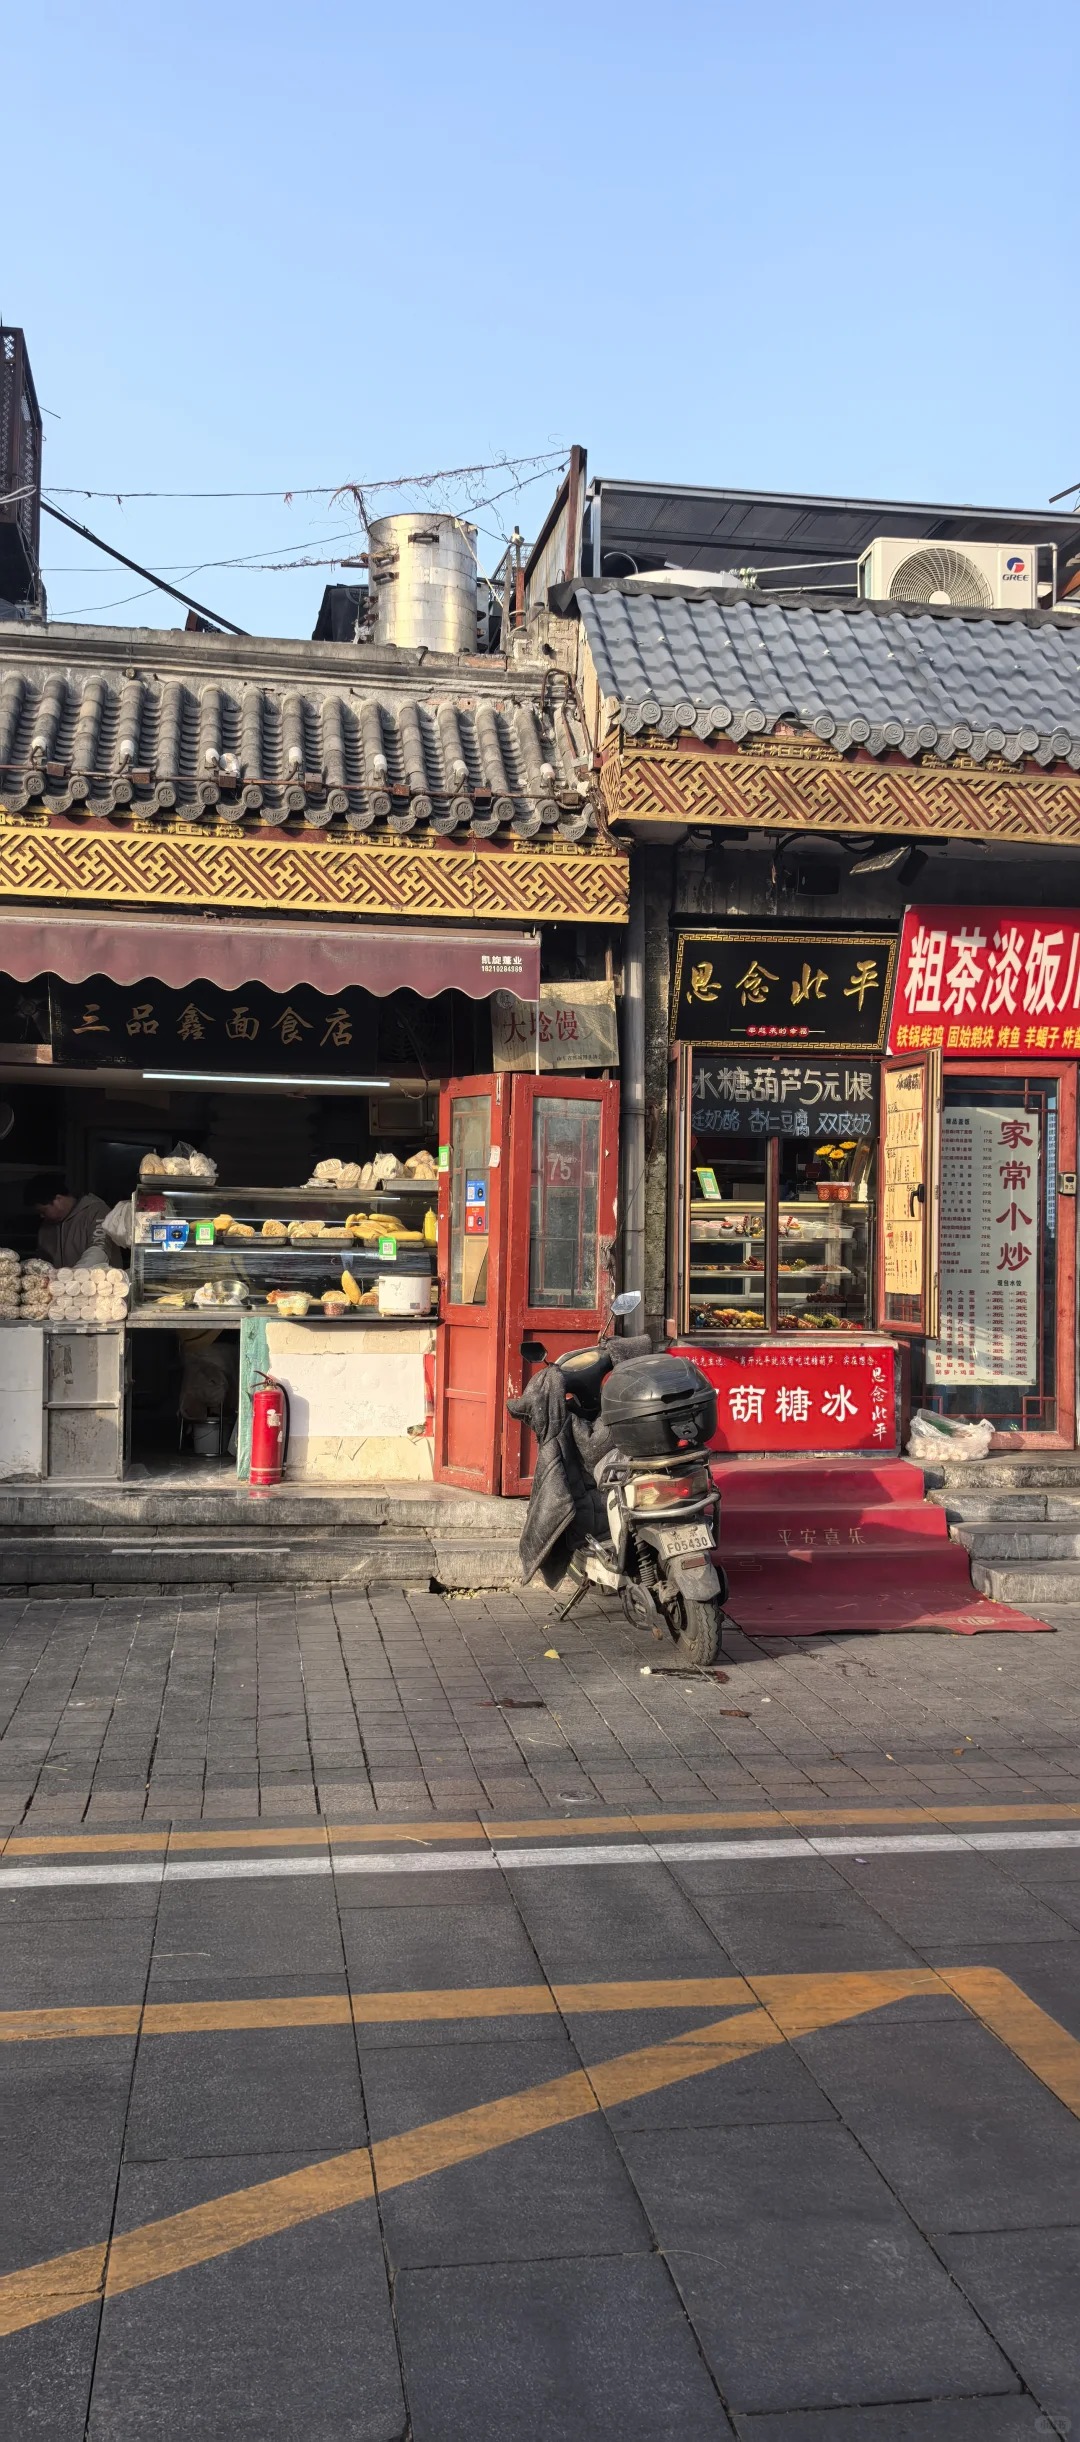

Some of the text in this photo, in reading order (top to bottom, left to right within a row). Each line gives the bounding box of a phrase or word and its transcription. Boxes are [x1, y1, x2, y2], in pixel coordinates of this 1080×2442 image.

[686, 960, 880, 1012] 思念北平
[72, 1002, 353, 1047] 三品鑫面食店
[503, 1010, 596, 1044] 大埝馒
[896, 1024, 945, 1048] 铁锅柴鸡
[947, 1025, 994, 1048] 固始鹅块
[997, 1026, 1020, 1048] 烤鱼
[1024, 1026, 1059, 1048] 羊蝎子
[748, 1107, 810, 1137] 杏仁豆腐
[815, 1111, 872, 1136] 双皮奶
[996, 1120, 1033, 1271] 家常小炒
[871, 1367, 888, 1443] 思念北平
[666, 1537, 708, 1554] F05430
[777, 1527, 866, 1546] 平安喜乐
